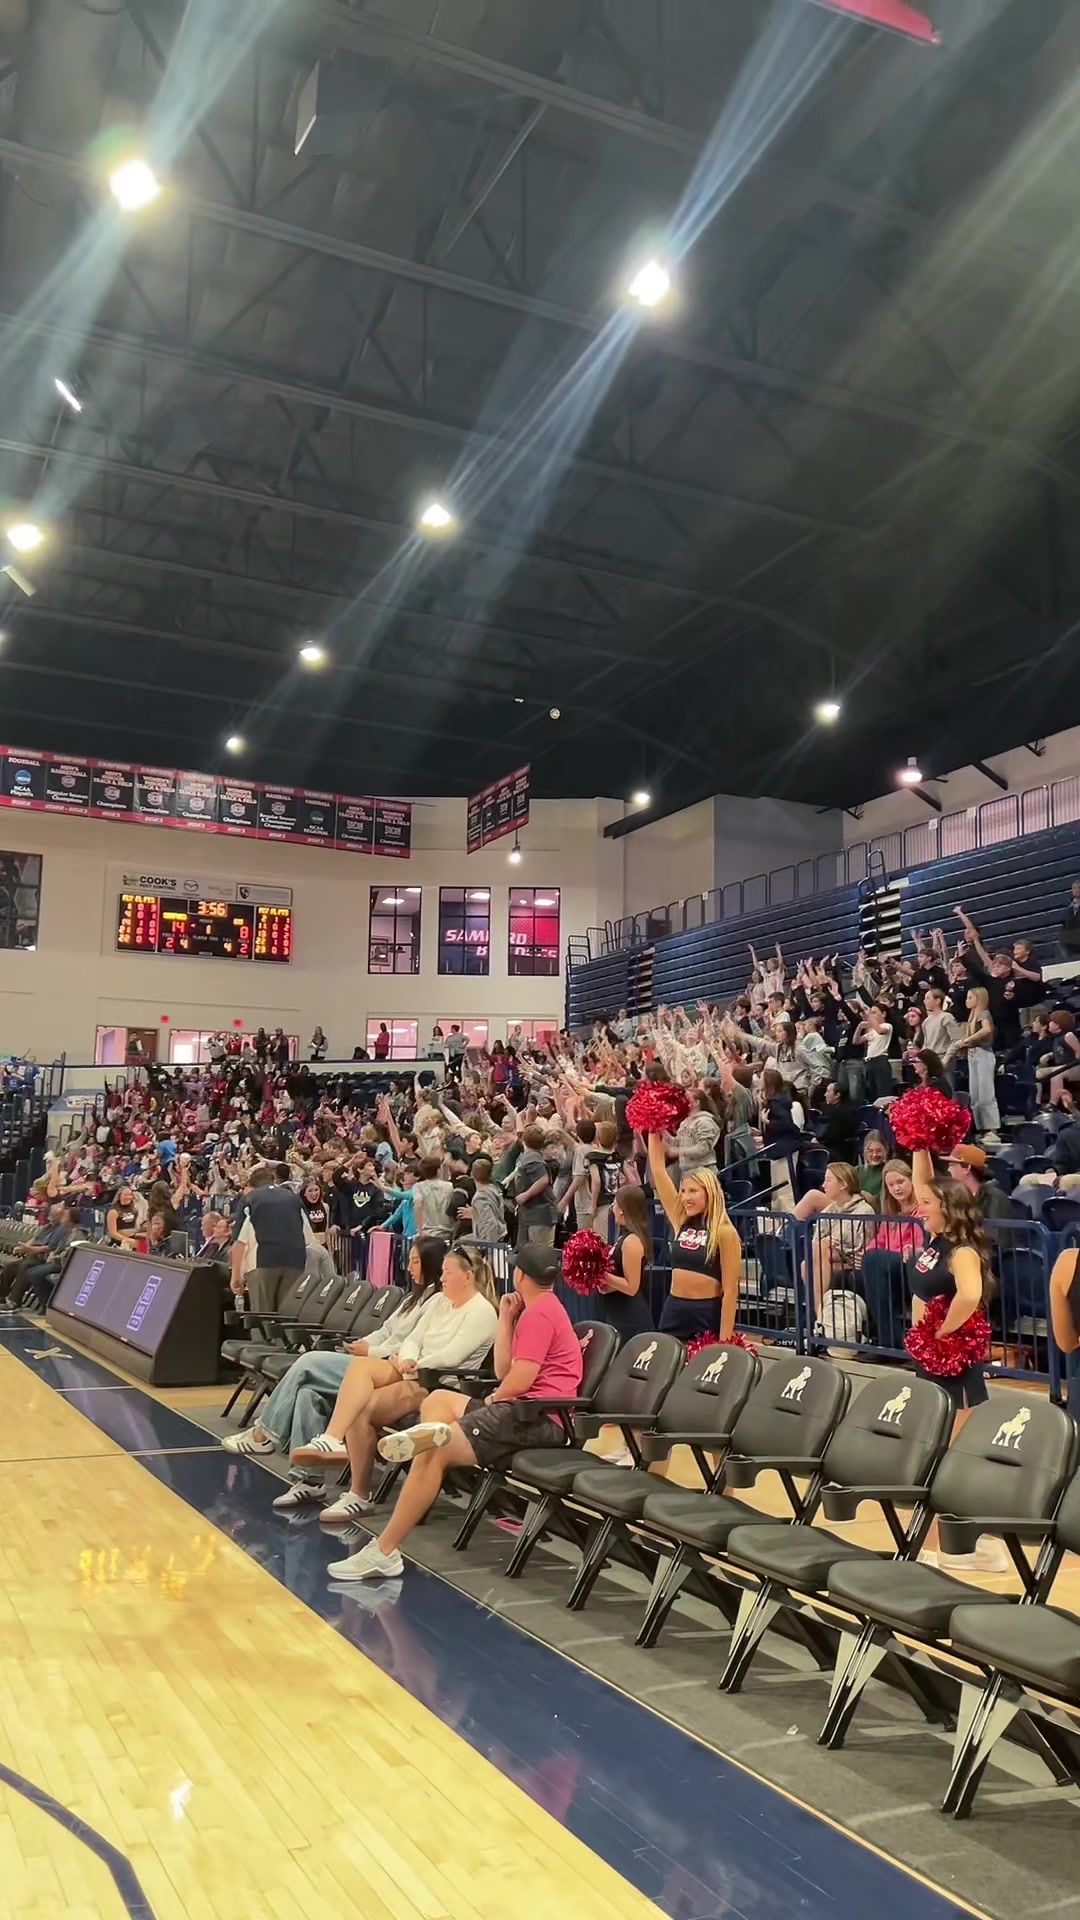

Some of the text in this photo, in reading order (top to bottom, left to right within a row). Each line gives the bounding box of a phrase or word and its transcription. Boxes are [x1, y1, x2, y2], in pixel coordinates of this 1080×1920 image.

[140, 876, 176, 886] COOK'S
[198, 901, 226, 917] 3:56
[172, 921, 184, 932] 14
[240, 926, 249, 938] 8
[166, 938, 174, 947] 2
[240, 944, 248, 953] 2
